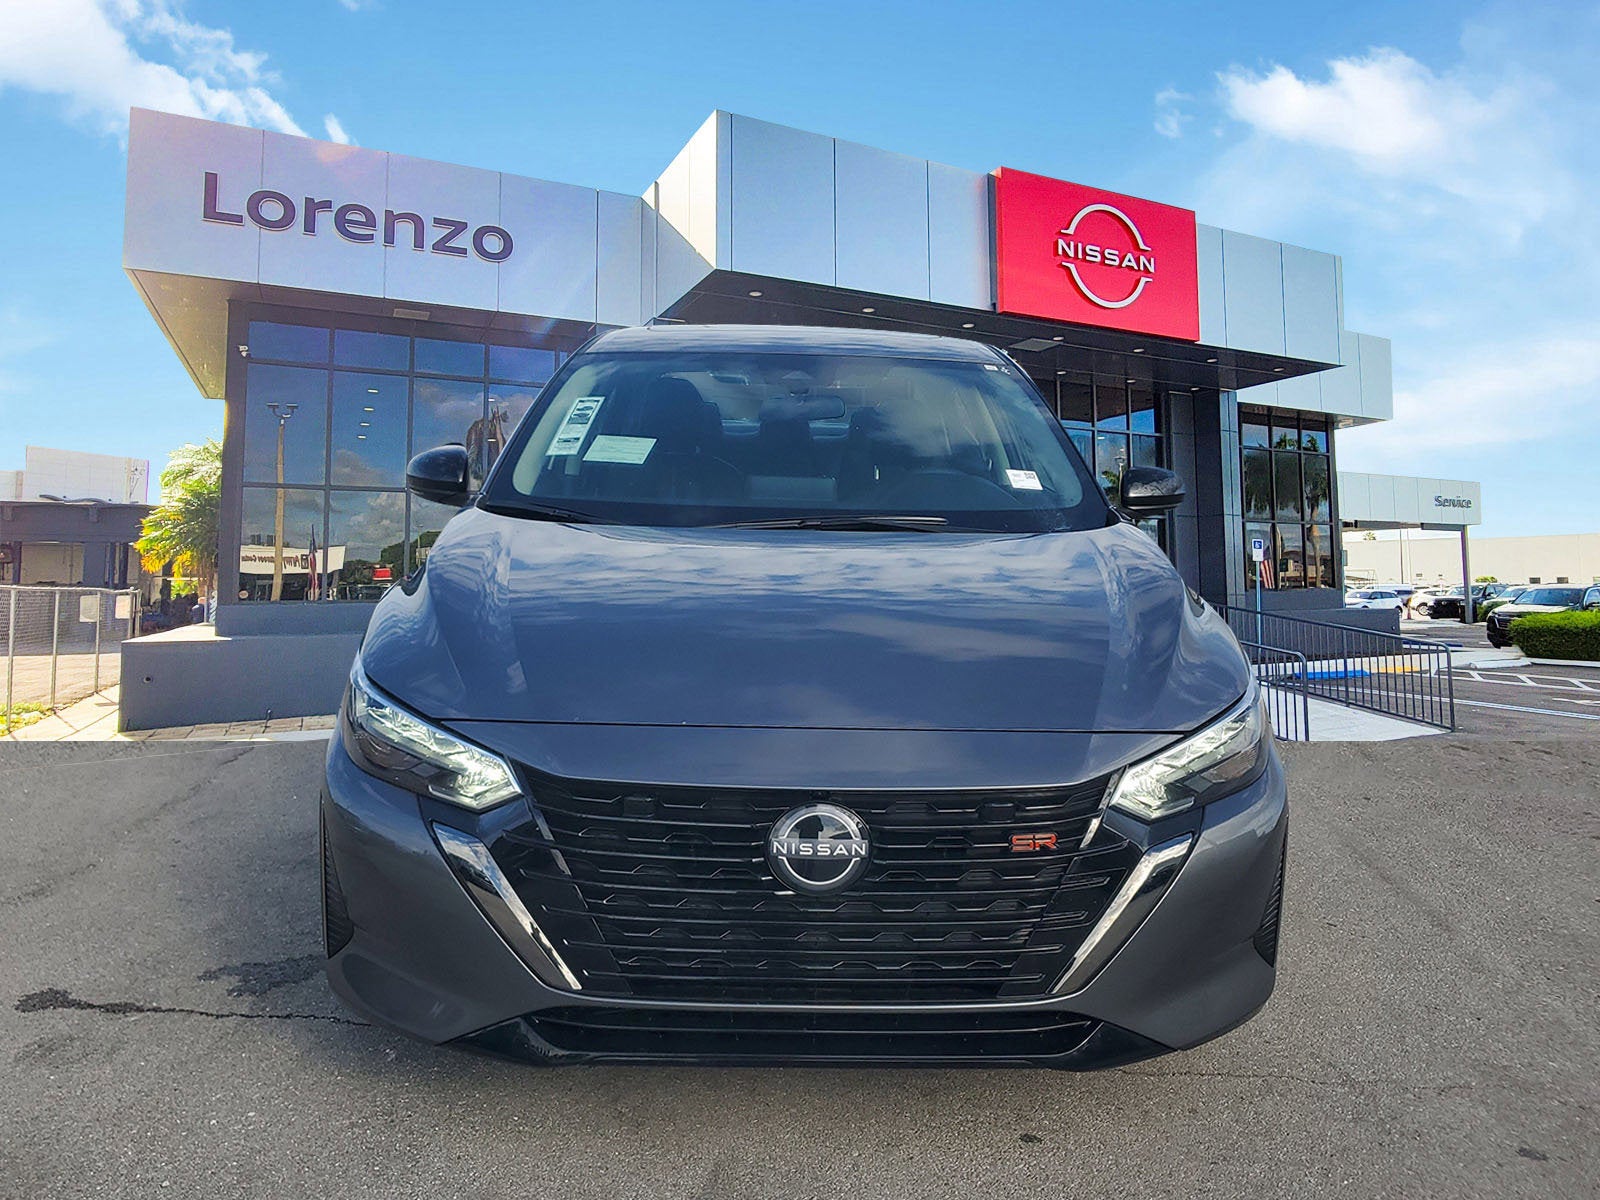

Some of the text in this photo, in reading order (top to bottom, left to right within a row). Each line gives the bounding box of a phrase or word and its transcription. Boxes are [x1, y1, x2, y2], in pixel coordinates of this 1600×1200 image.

[202, 171, 514, 262] Lorenzo
[1056, 238, 1155, 273] NISSAN
[1434, 495, 1472, 509] Service
[773, 842, 866, 856] NISSAN
[1011, 833, 1057, 851] SR
